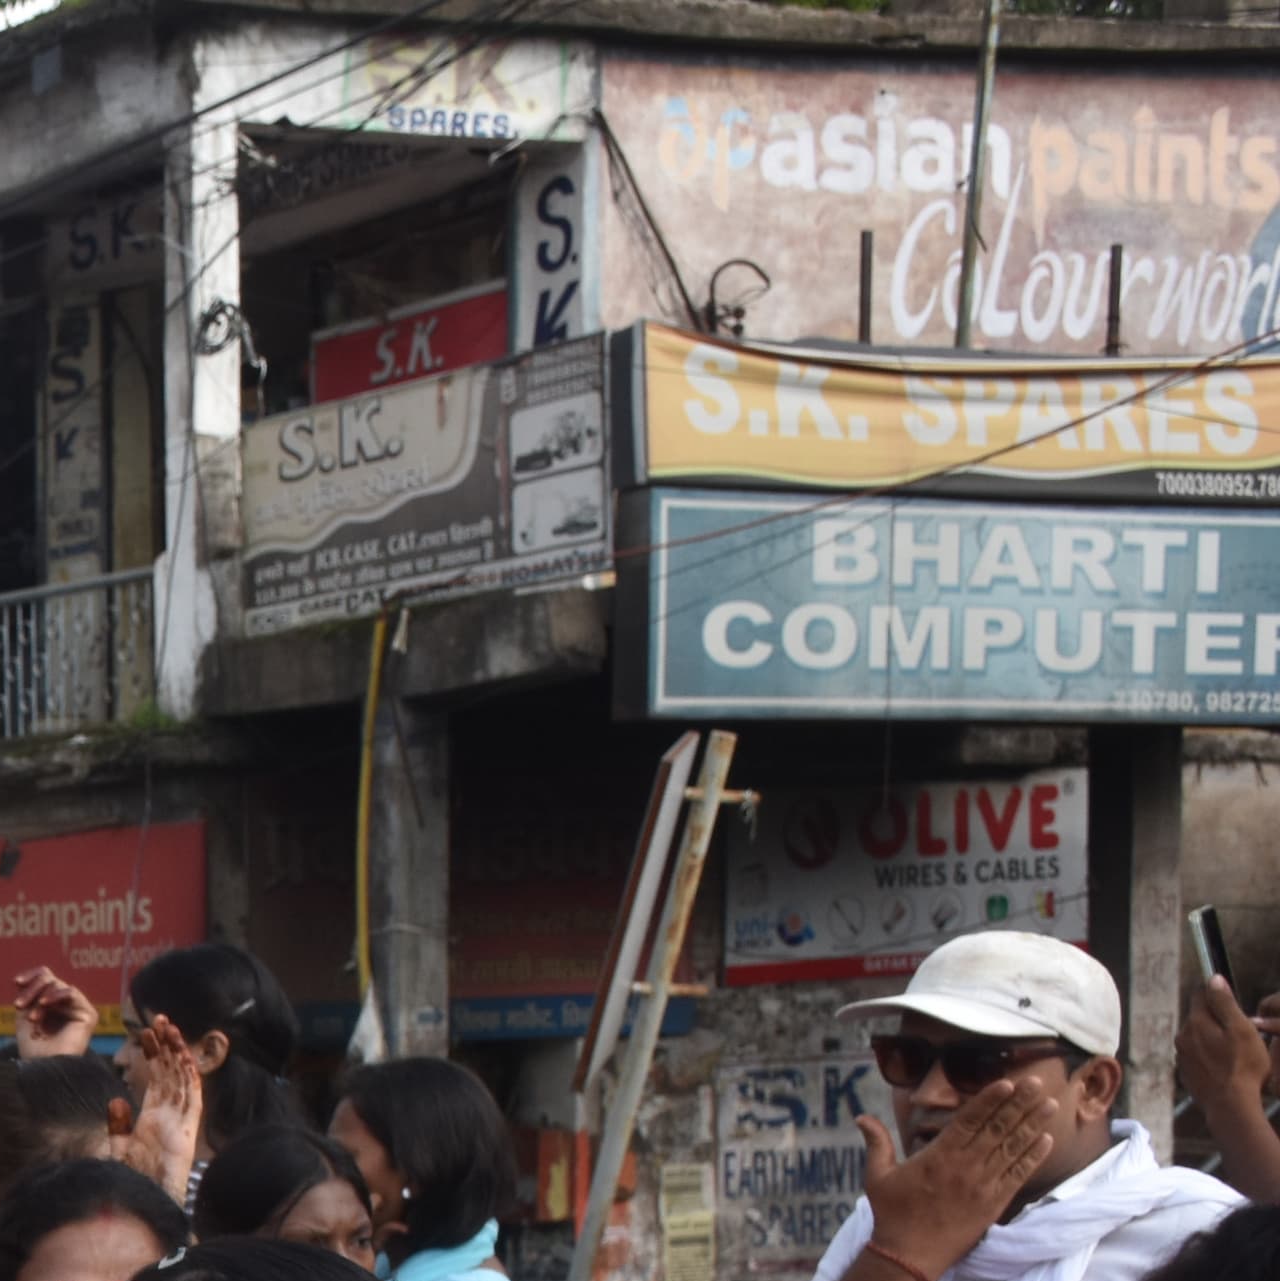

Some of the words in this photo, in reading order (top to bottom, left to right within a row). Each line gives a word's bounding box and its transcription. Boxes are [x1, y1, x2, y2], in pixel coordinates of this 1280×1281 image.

[761, 90, 1013, 198] asian
[1028, 104, 1280, 247] paints
[683, 344, 869, 442] S.K.
[902, 370, 1260, 456] SPARES
[278, 400, 405, 482] S.K.
[812, 517, 1221, 595] BHARTI
[858, 784, 1060, 860] OLIVE
[874, 861, 947, 889] WIRES
[954, 862, 969, 886] &
[974, 855, 1062, 886] CABLES
